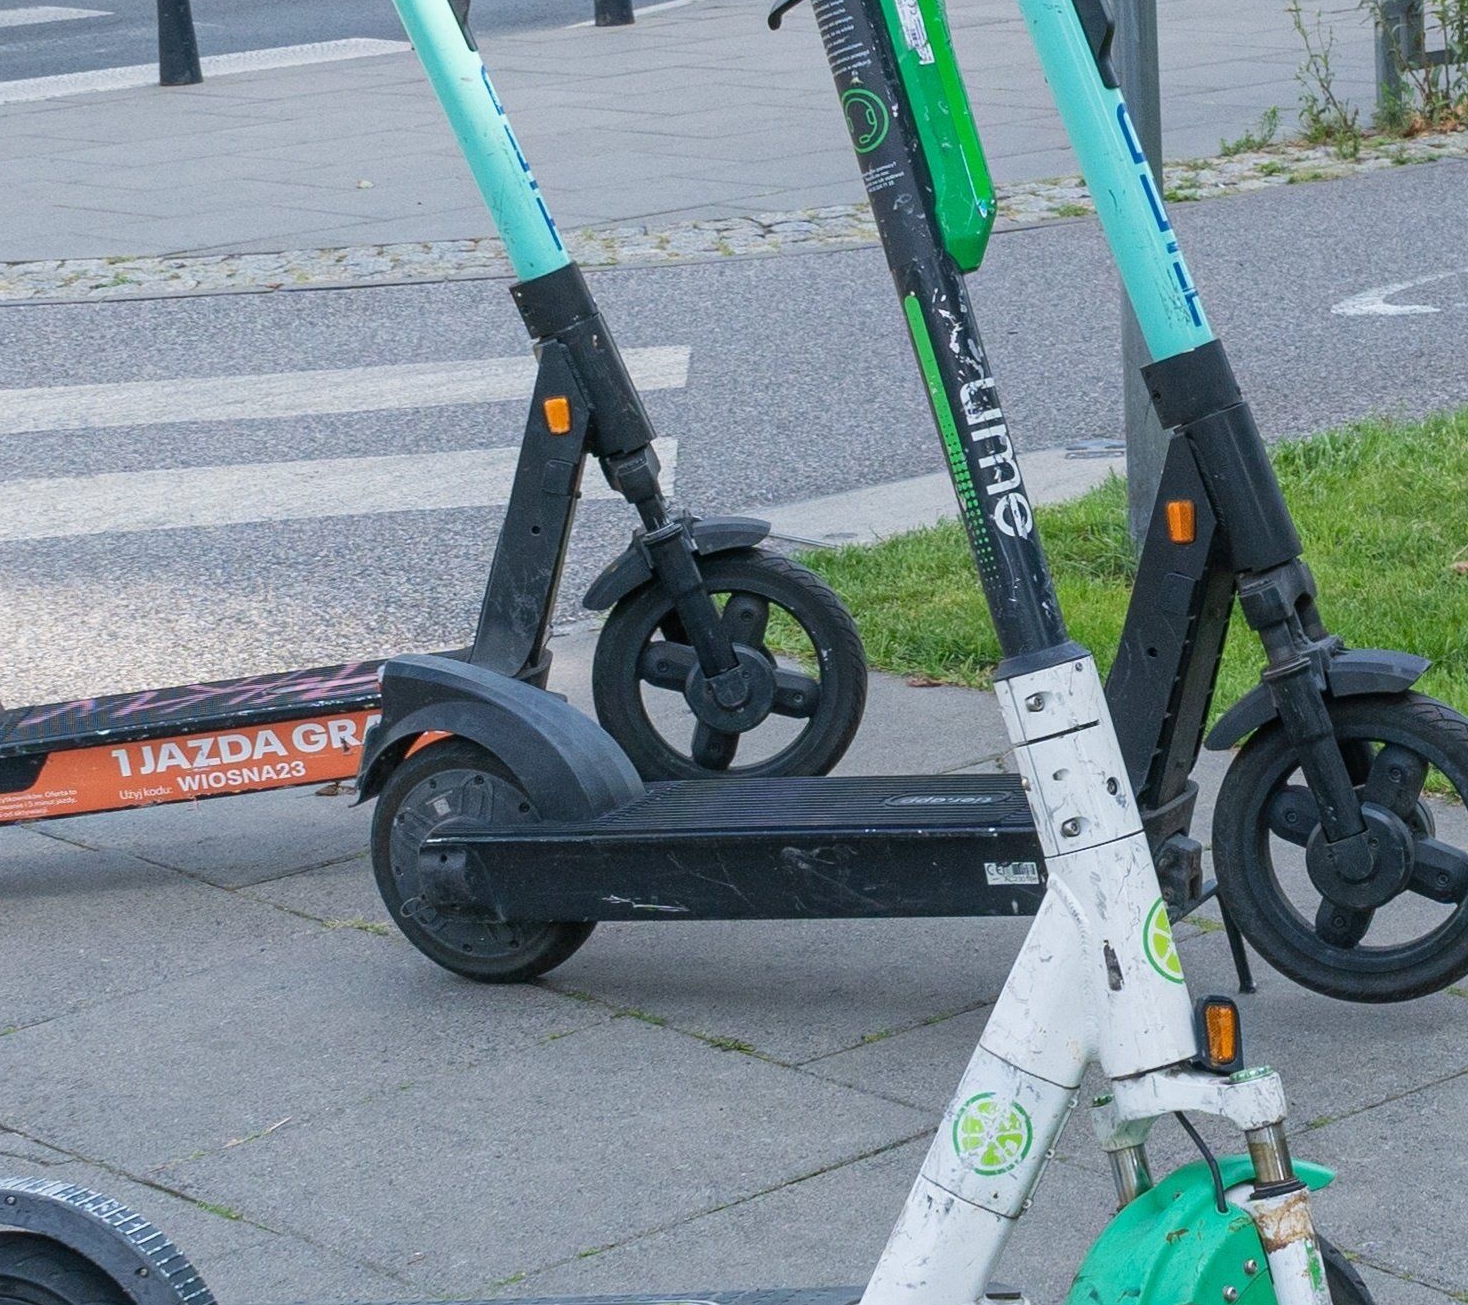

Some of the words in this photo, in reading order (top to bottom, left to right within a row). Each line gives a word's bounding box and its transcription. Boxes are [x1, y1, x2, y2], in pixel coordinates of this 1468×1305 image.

[111, 749, 132, 777] 1
[140, 729, 289, 775] JAZDA
[176, 761, 306, 792] WIOSNA23
